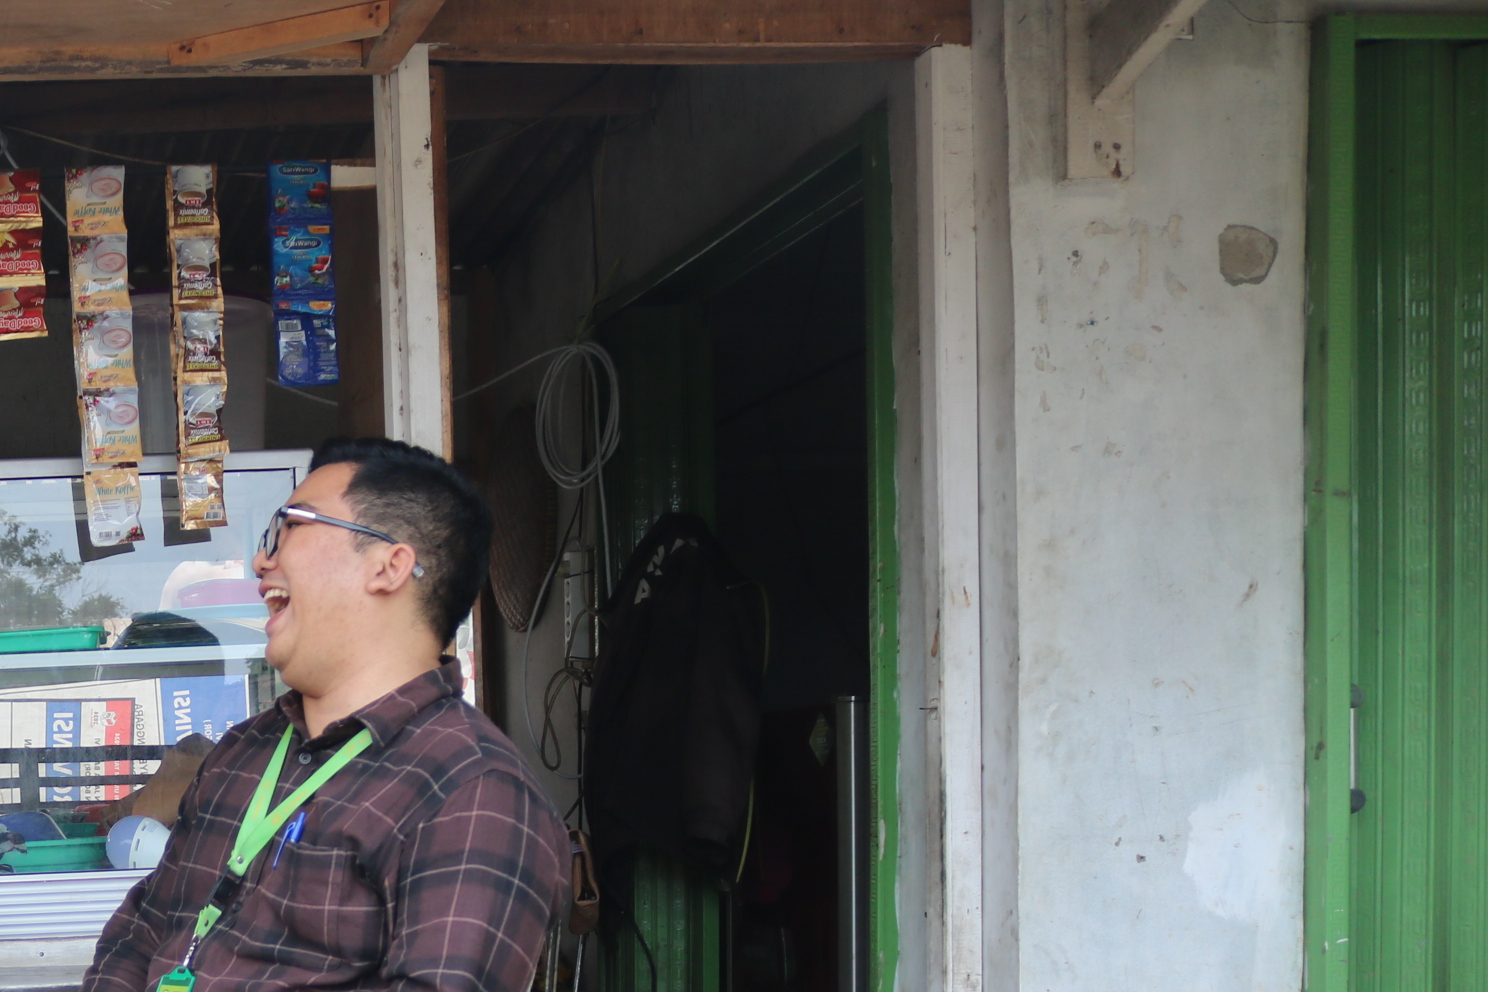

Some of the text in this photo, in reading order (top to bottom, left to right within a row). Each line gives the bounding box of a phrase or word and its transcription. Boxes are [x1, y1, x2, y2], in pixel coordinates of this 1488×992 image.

[12, 203, 36, 214] Good
[73, 203, 121, 218] White Koffie
[15, 260, 38, 271] Good
[17, 317, 41, 328] Good
